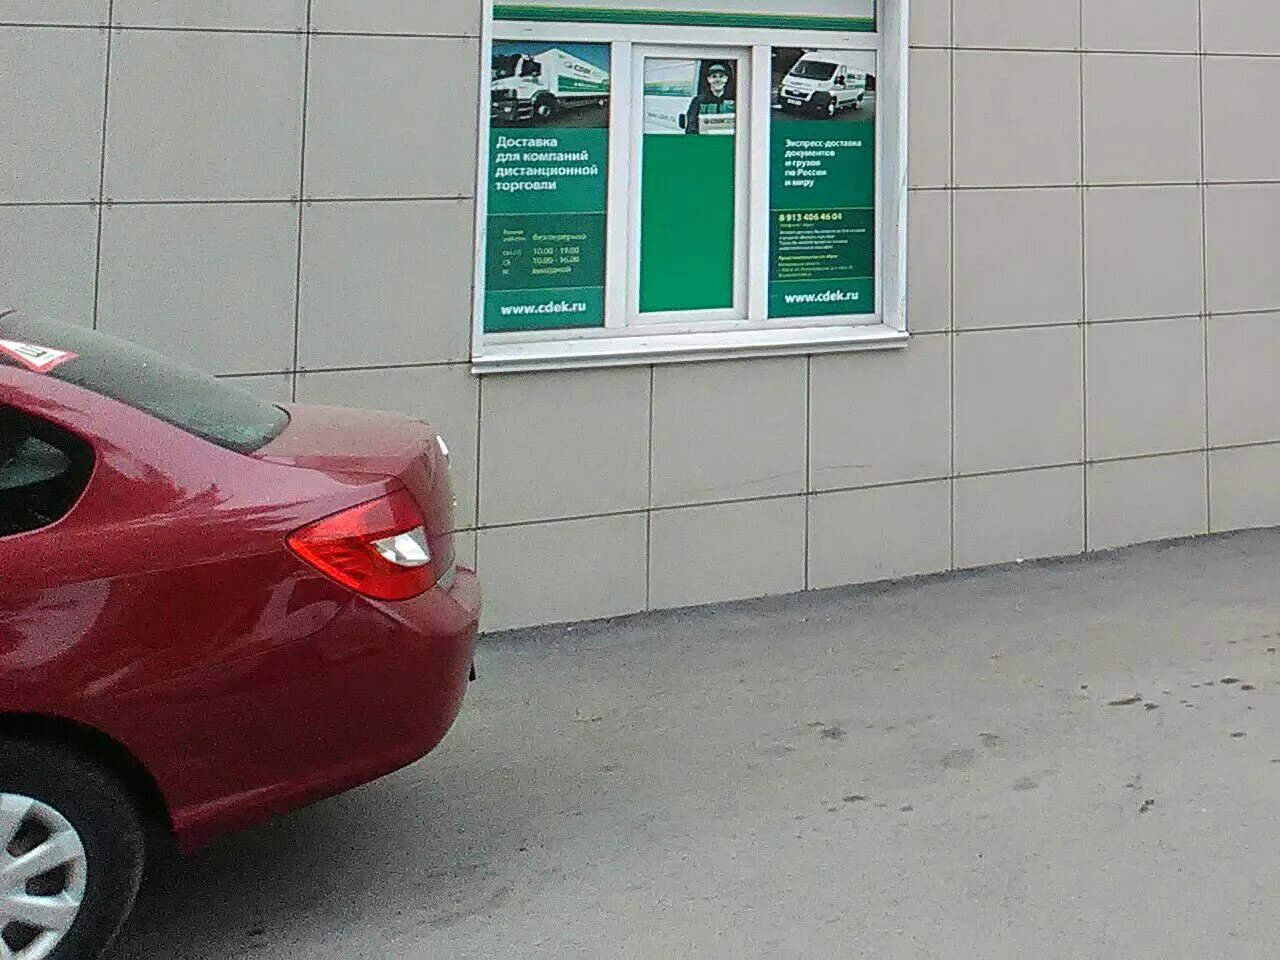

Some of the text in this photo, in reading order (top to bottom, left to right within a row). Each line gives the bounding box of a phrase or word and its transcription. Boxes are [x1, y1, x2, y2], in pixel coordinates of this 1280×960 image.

[496, 136, 558, 149] Доставка
[784, 139, 862, 149] Экспресс-доставка
[496, 150, 589, 163] для компаний
[784, 150, 836, 159] документов
[792, 160, 821, 168] грузов
[495, 164, 599, 178] дистанционной
[796, 168, 827, 177] России
[495, 180, 557, 192] торговли
[792, 179, 815, 188] миру
[784, 290, 859, 304] www.cdek.ru
[500, 301, 587, 316] www.cdek.ru
